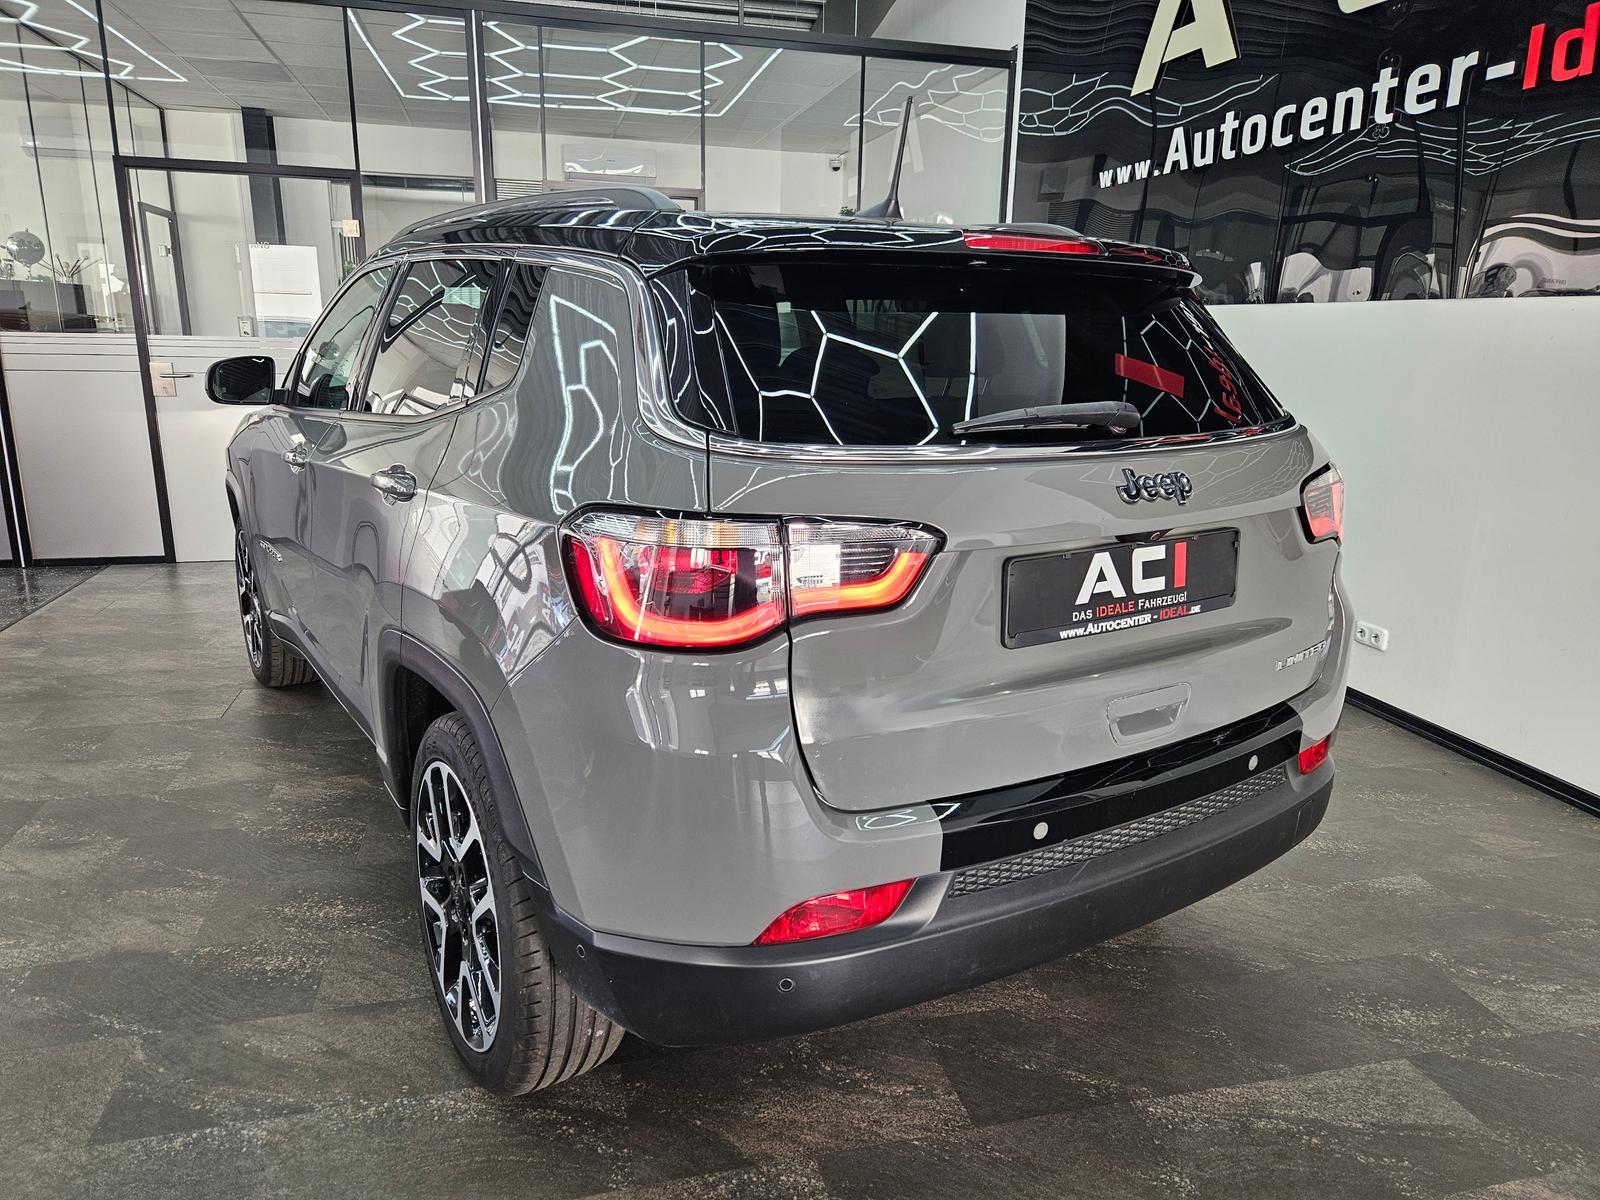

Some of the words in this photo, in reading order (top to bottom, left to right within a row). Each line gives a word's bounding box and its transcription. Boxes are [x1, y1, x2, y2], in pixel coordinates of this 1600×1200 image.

[1116, 467, 1194, 506] Jeep
[1074, 541, 1188, 606] ACI
[1072, 609, 1093, 622] DAS
[1096, 600, 1135, 618] IDEALE
